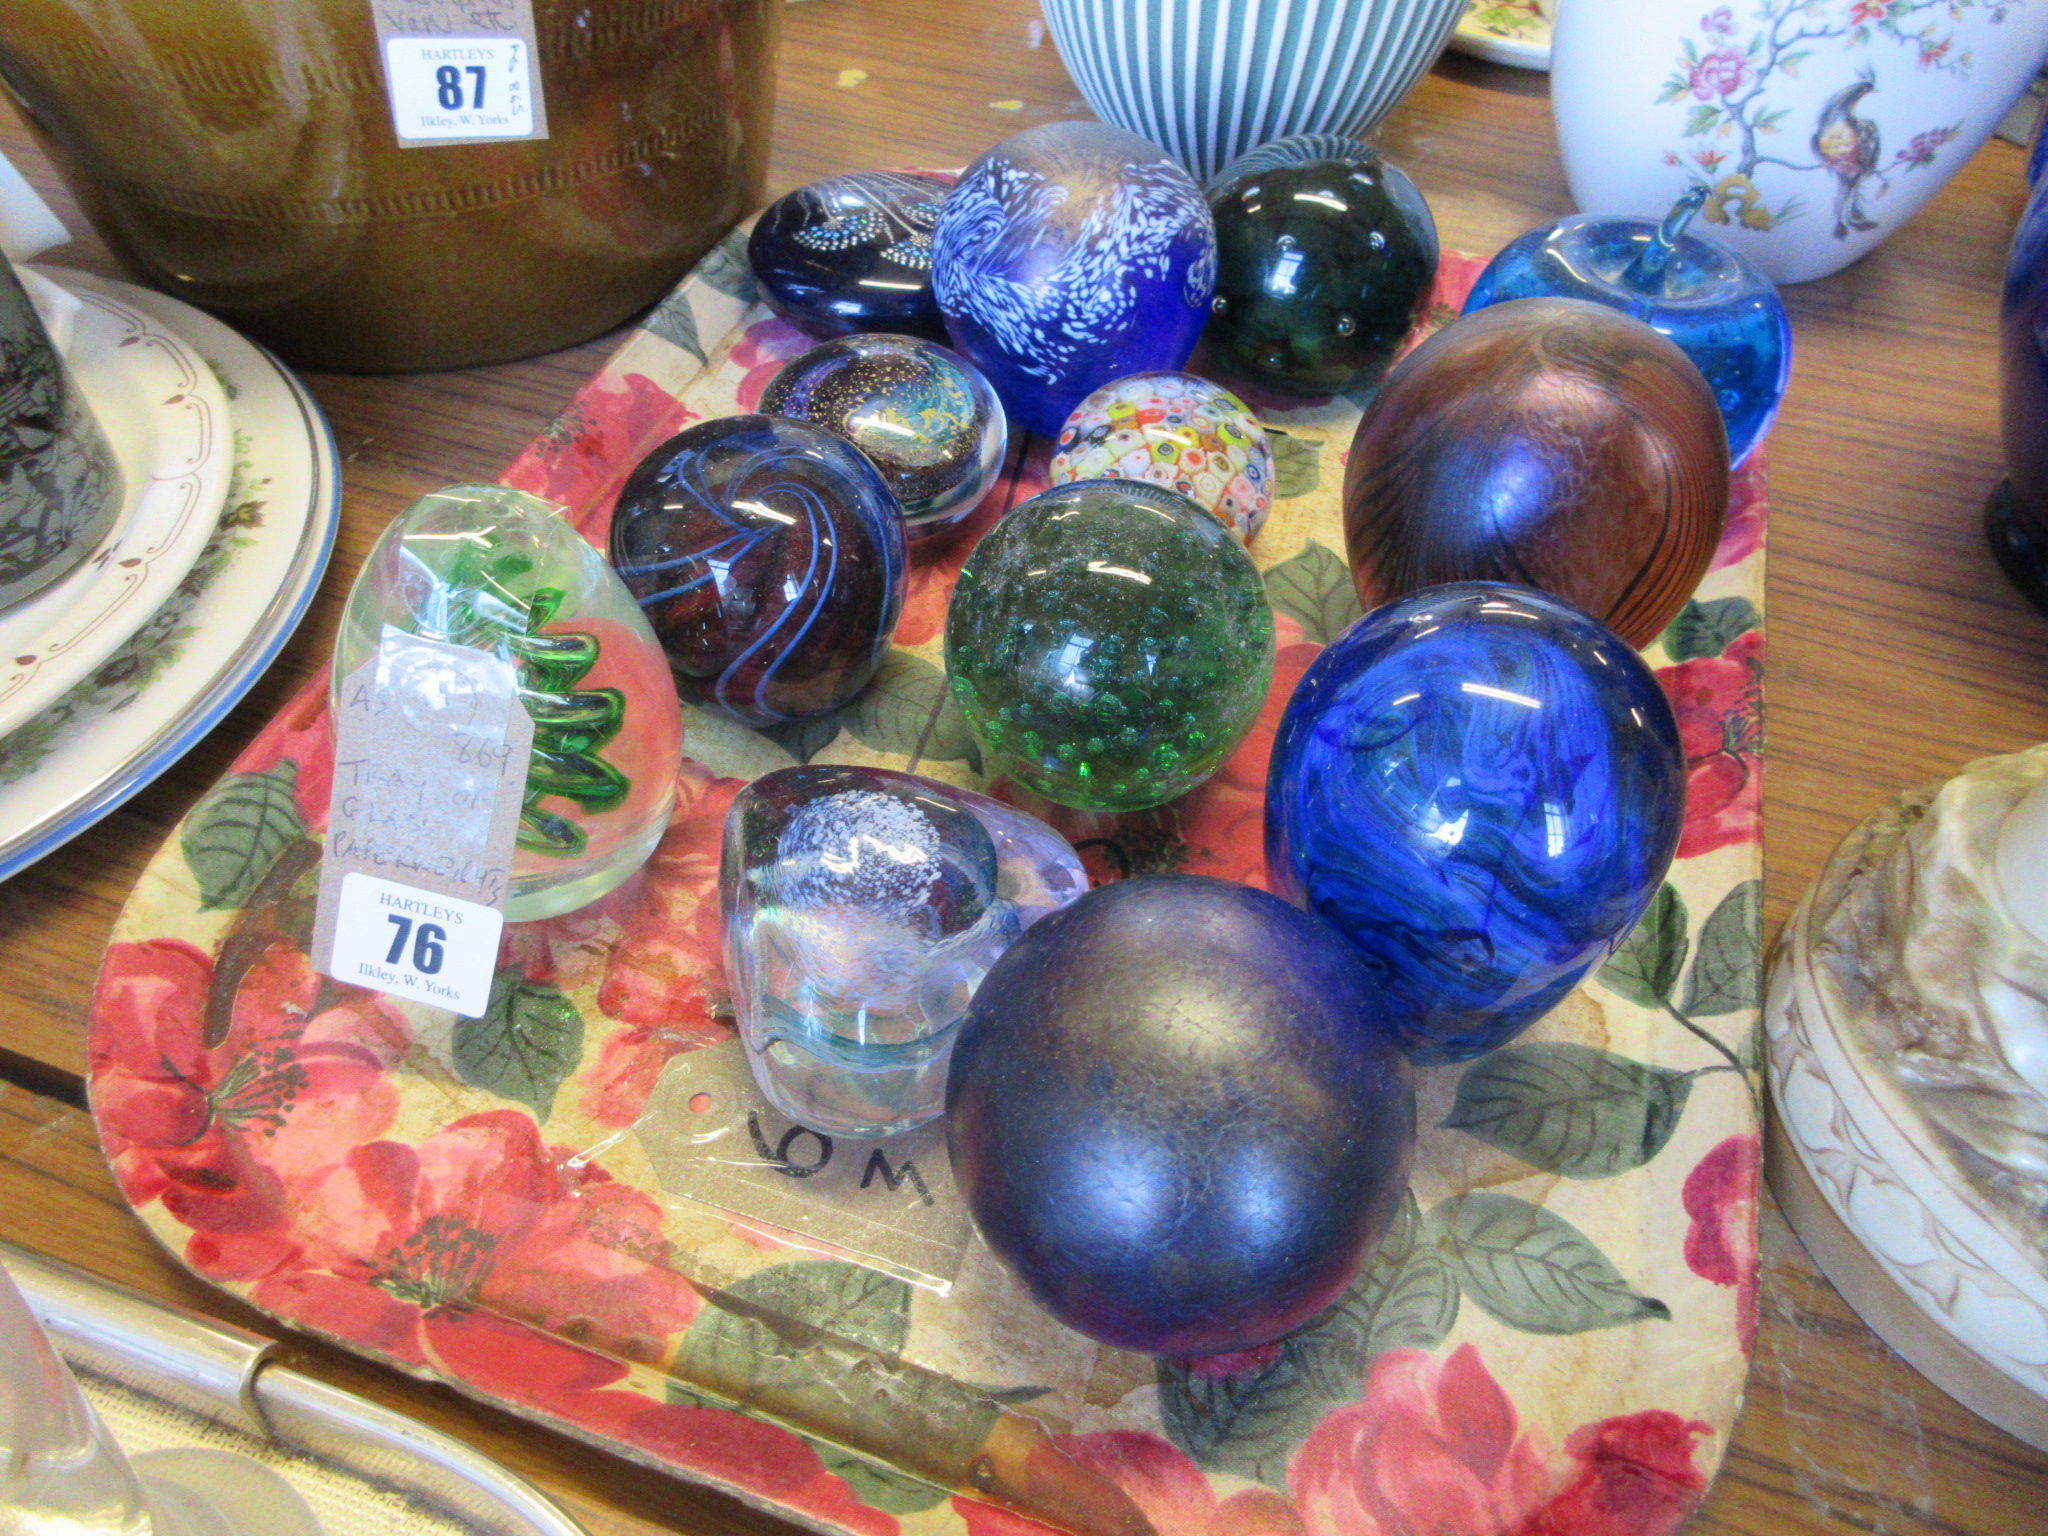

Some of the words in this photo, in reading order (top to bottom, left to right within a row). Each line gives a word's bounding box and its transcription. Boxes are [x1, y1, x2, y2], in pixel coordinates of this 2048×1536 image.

[421, 48, 495, 61] HARTLEYS
[436, 65, 487, 111] 87
[421, 115, 458, 128] Ilkley,
[459, 114, 476, 125] W.
[478, 113, 510, 125] Yorks
[451, 731, 513, 777] 869
[338, 757, 427, 807] TRAY
[379, 892, 464, 925] HARTLEYS
[385, 913, 448, 976] 76
[358, 962, 400, 985] Ilkley,
[403, 974, 420, 989] W.
[425, 979, 461, 1001] Yorks
